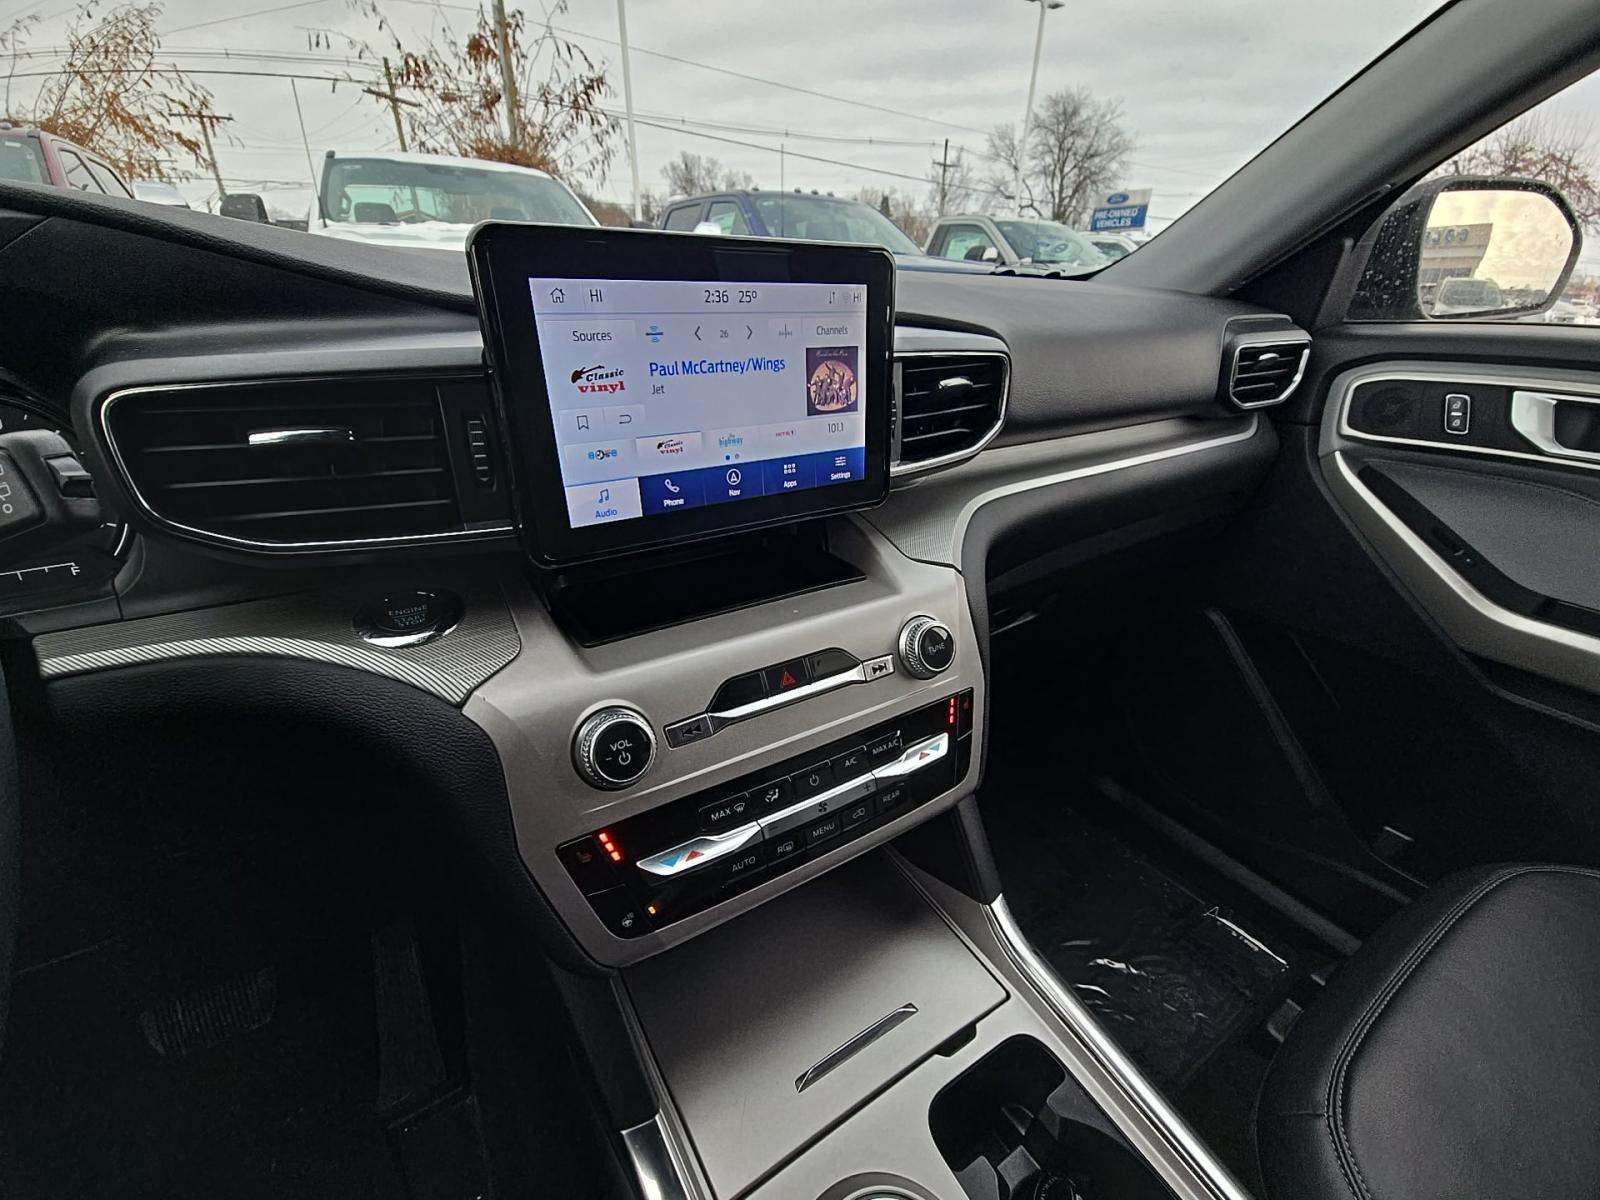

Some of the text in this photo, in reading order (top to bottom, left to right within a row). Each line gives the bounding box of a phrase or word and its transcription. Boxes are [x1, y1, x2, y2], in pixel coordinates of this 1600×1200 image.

[589, 289, 603, 303] HI
[704, 290, 729, 304] 2:36
[572, 330, 613, 343] Sources
[719, 329, 729, 338] 26
[816, 325, 849, 336] Channels
[649, 357, 786, 377] Paul McCartney/Wings
[585, 368, 625, 383] Classic
[577, 380, 626, 395] vinyl
[651, 384, 666, 395] Jet
[830, 470, 851, 482] Settings
[783, 479, 798, 489] Apps
[728, 488, 741, 497] Nav
[663, 497, 685, 508] Phone
[595, 508, 618, 519] Audio
[609, 740, 633, 752] VOL
[844, 756, 858, 768] A/C
[711, 807, 732, 822] MAX
[812, 822, 836, 838] MENU
[731, 856, 757, 873] AUTO
